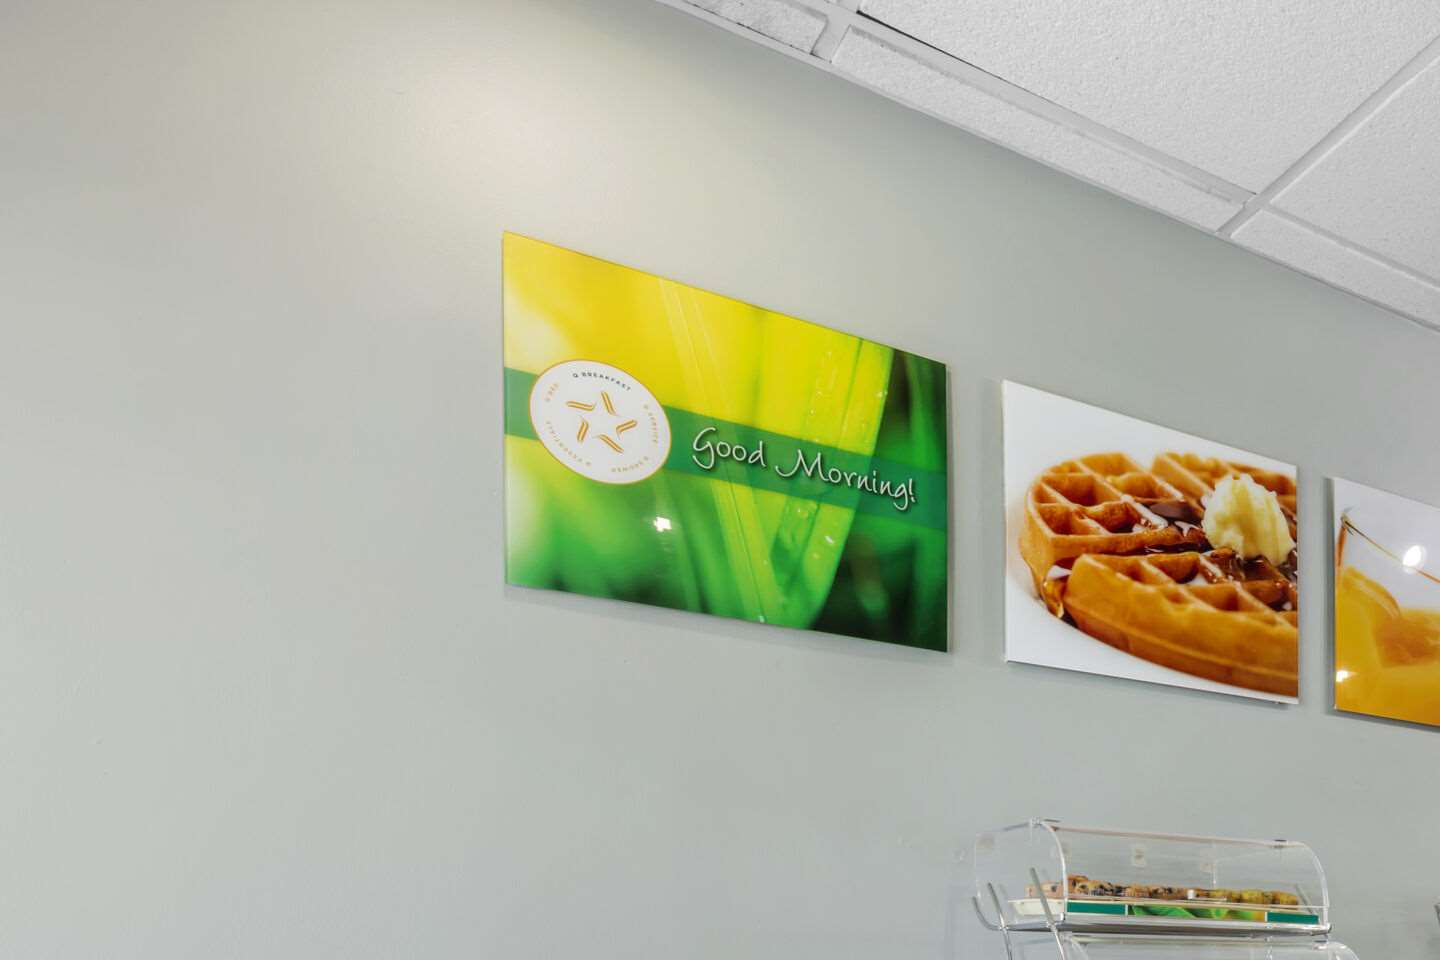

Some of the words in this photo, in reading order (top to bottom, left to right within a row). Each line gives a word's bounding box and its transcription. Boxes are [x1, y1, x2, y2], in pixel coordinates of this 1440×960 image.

[581, 371, 631, 391] BREAKFAST
[692, 426, 767, 470] Good
[774, 448, 917, 511] Morning!
